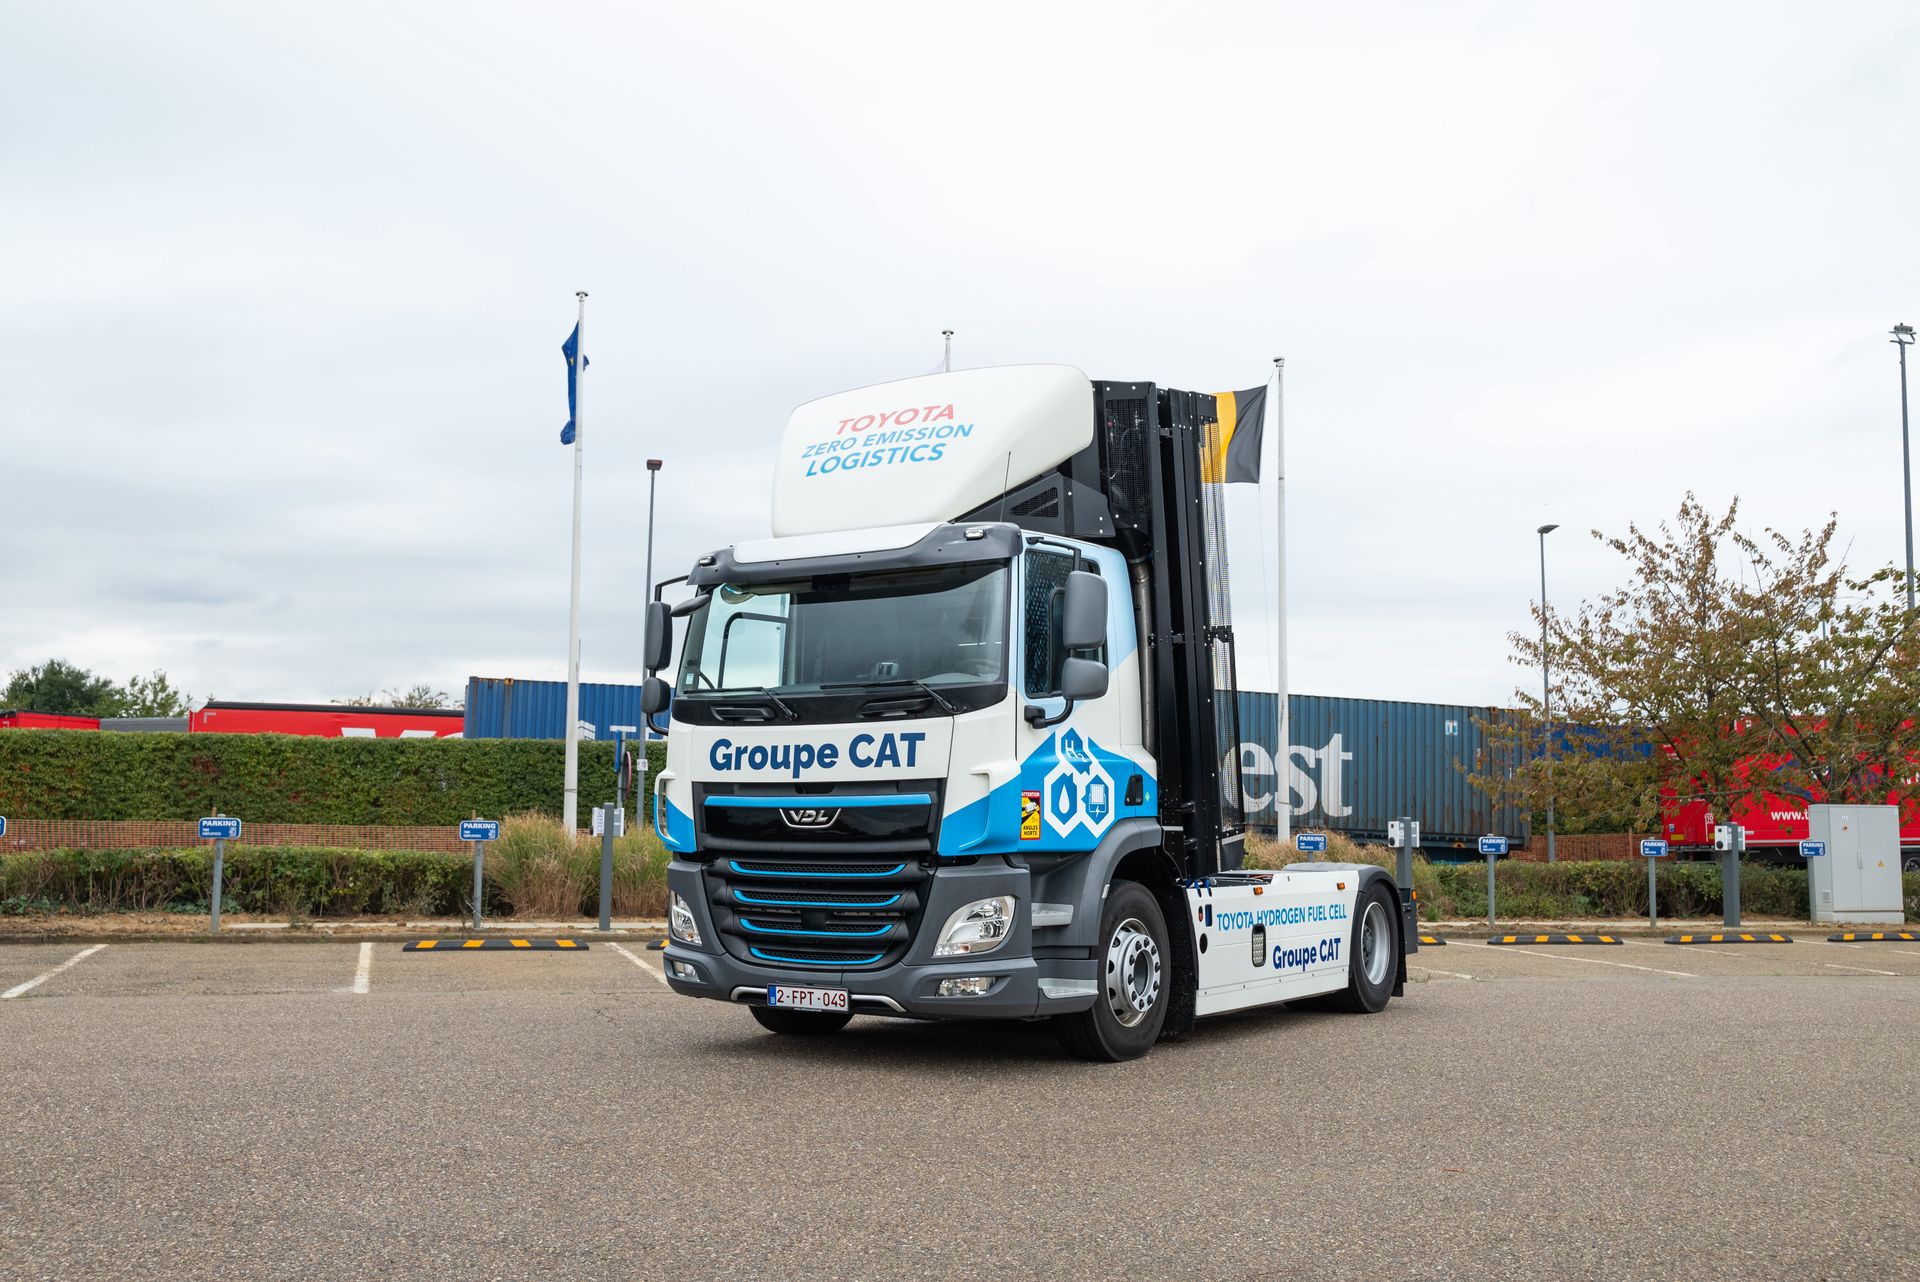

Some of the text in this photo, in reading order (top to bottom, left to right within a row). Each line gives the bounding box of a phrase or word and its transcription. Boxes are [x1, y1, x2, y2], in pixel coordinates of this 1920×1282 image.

[836, 403, 955, 436] TOYOTA
[801, 423, 974, 459] ZERO EMISSION
[805, 443, 947, 478] LOGISTICS
[709, 732, 926, 779] Groupe CAT
[789, 809, 829, 823] VDL
[1216, 903, 1347, 931] TOYOTA HYDROGEN FUEL CELL
[1272, 937, 1341, 972] Groupe CAT
[776, 988, 846, 1008] 2-FPT-049
